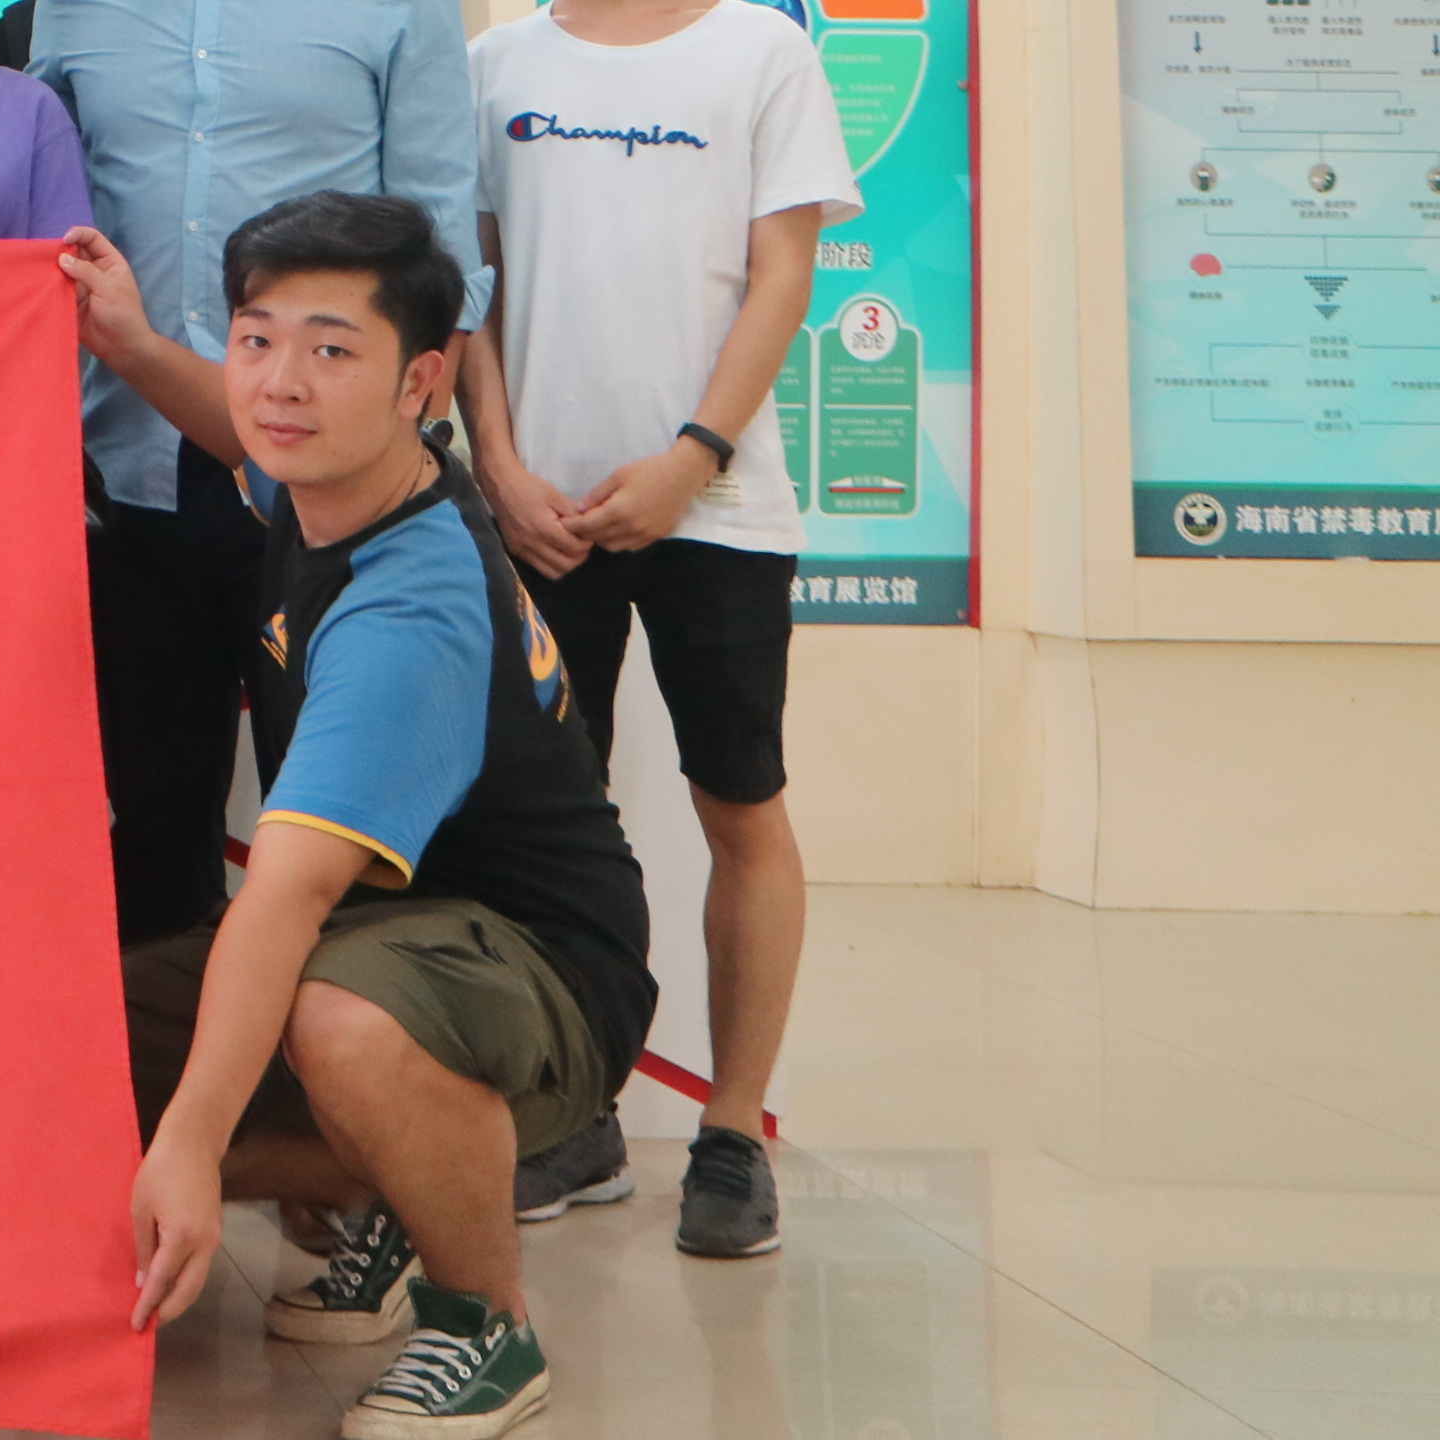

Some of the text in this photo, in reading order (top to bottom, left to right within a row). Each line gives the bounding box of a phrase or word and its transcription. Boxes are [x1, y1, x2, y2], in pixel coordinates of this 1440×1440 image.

[506, 111, 709, 158] Champion
[816, 241, 872, 269] 阶段
[862, 306, 880, 331] 3
[1235, 504, 1440, 536] 海南省禁毒教育
